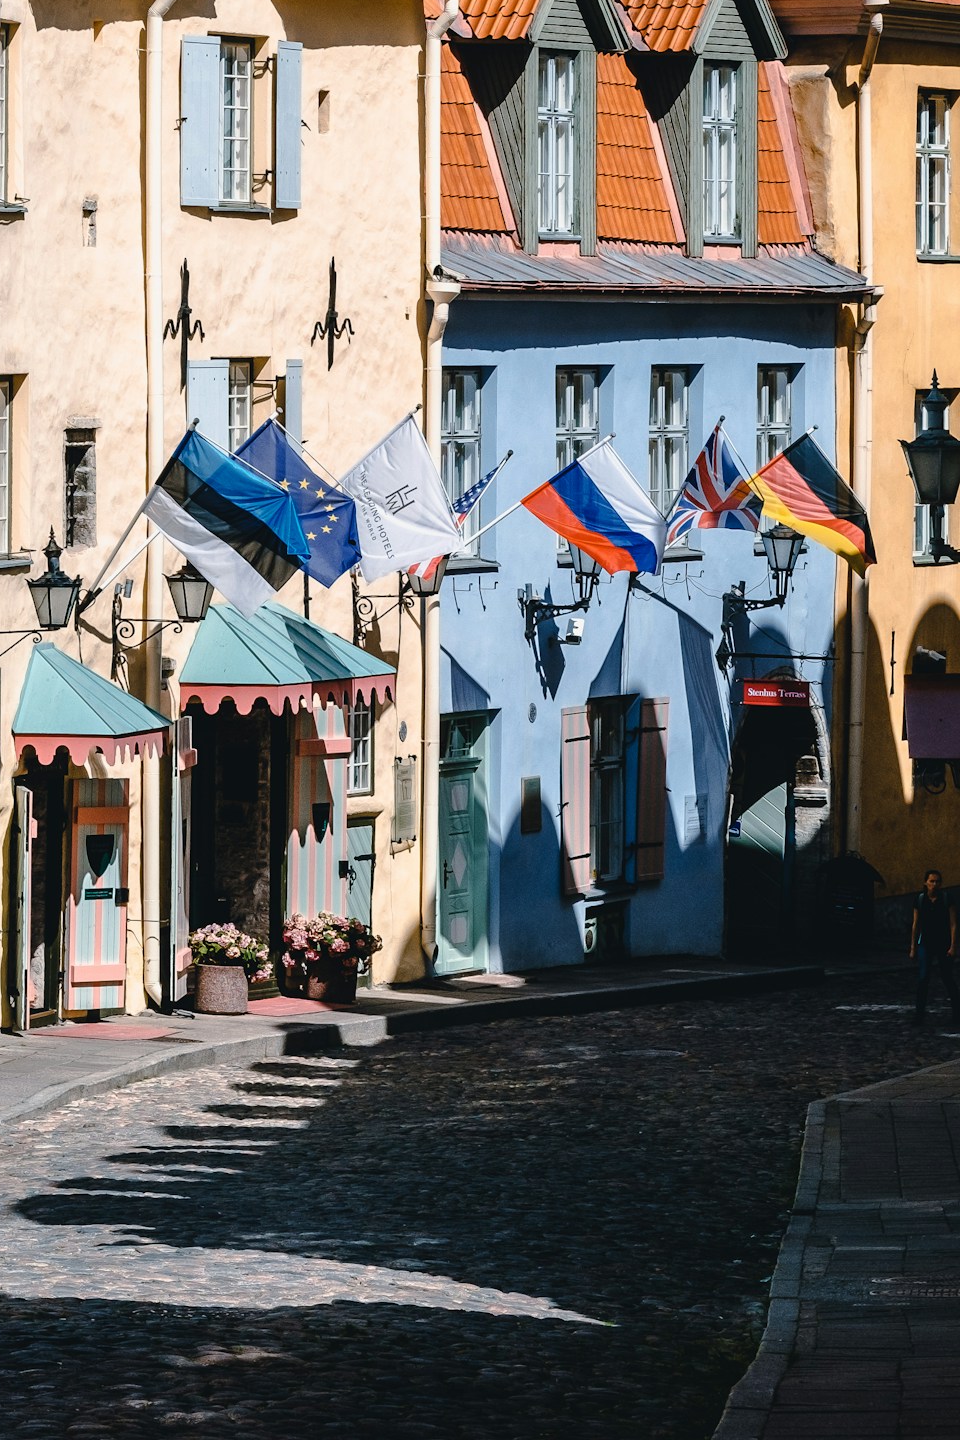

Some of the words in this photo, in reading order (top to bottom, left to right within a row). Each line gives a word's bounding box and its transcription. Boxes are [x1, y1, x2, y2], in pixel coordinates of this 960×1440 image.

[366, 518, 377, 541] WORLD
[376, 524, 395, 559] HOTELS
[748, 687, 777, 697] Stenhus
[778, 689, 806, 698] Terrass
